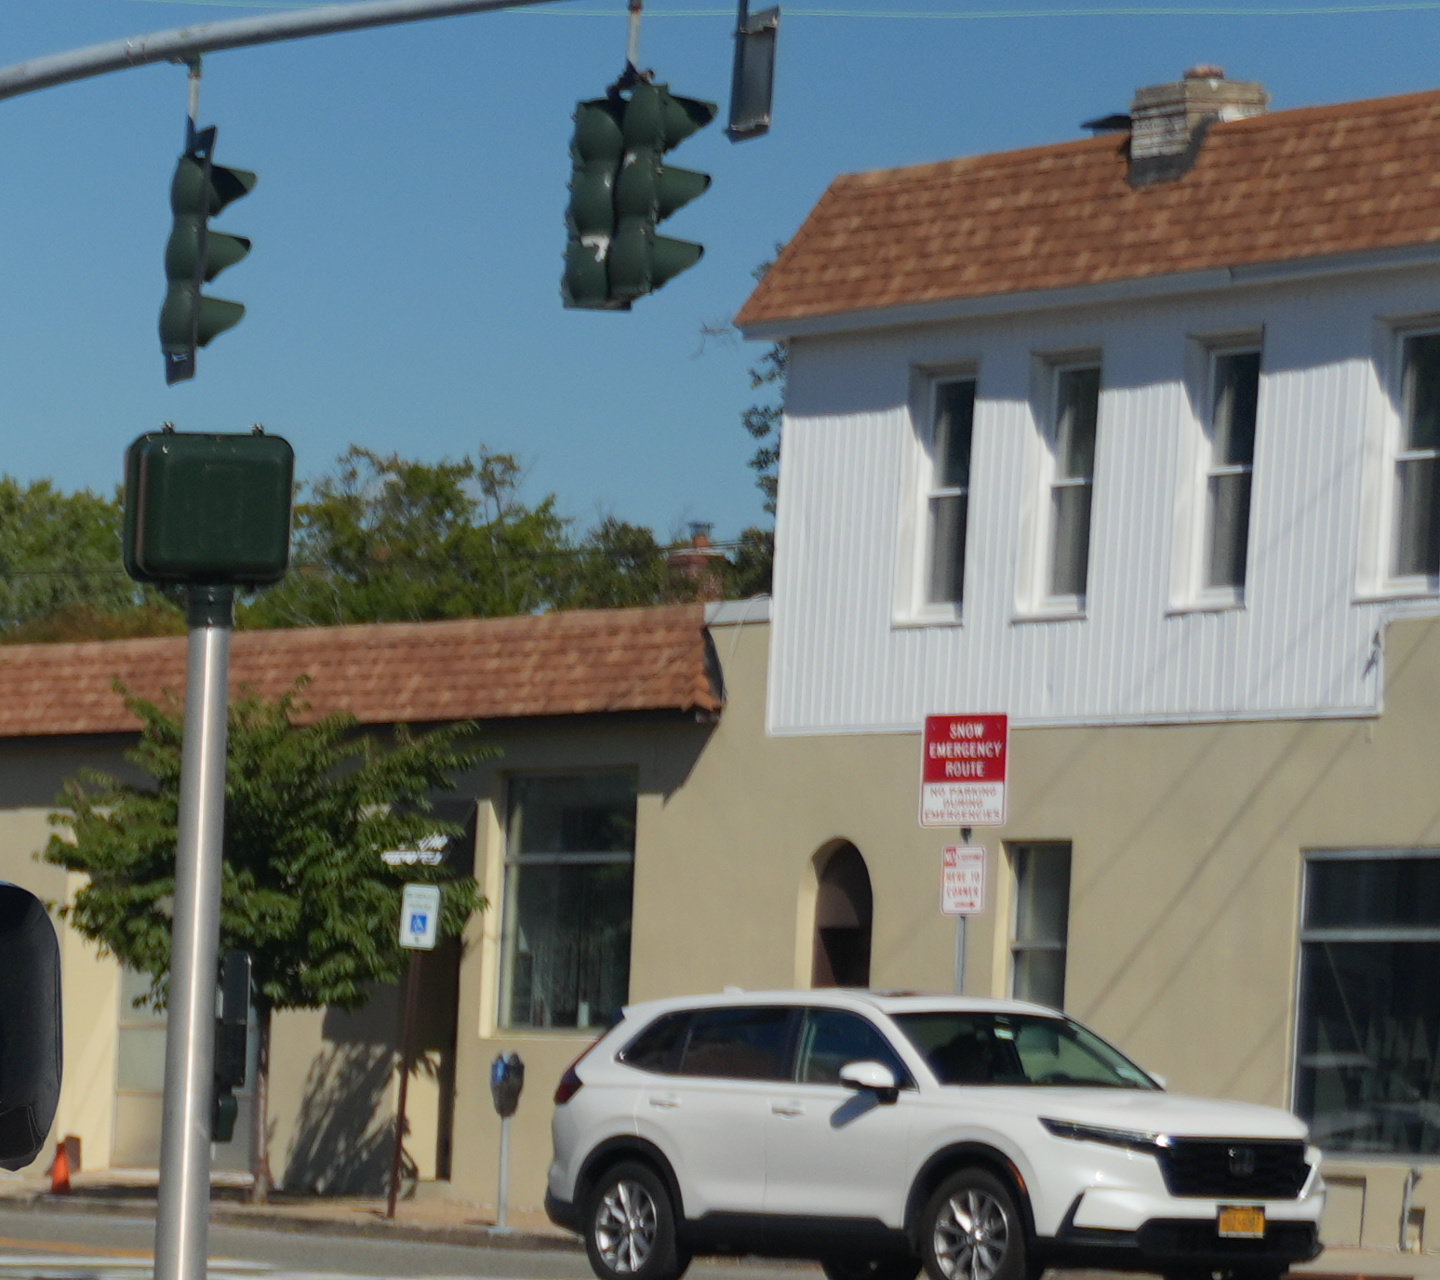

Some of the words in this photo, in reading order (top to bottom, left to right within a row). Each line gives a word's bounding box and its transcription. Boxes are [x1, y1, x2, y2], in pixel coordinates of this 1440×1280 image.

[949, 722, 984, 739] SNOW
[929, 742, 1002, 758] EMERGENCY
[945, 761, 985, 777] ROUTE
[930, 786, 945, 797] NO
[949, 786, 996, 797] PARKING
